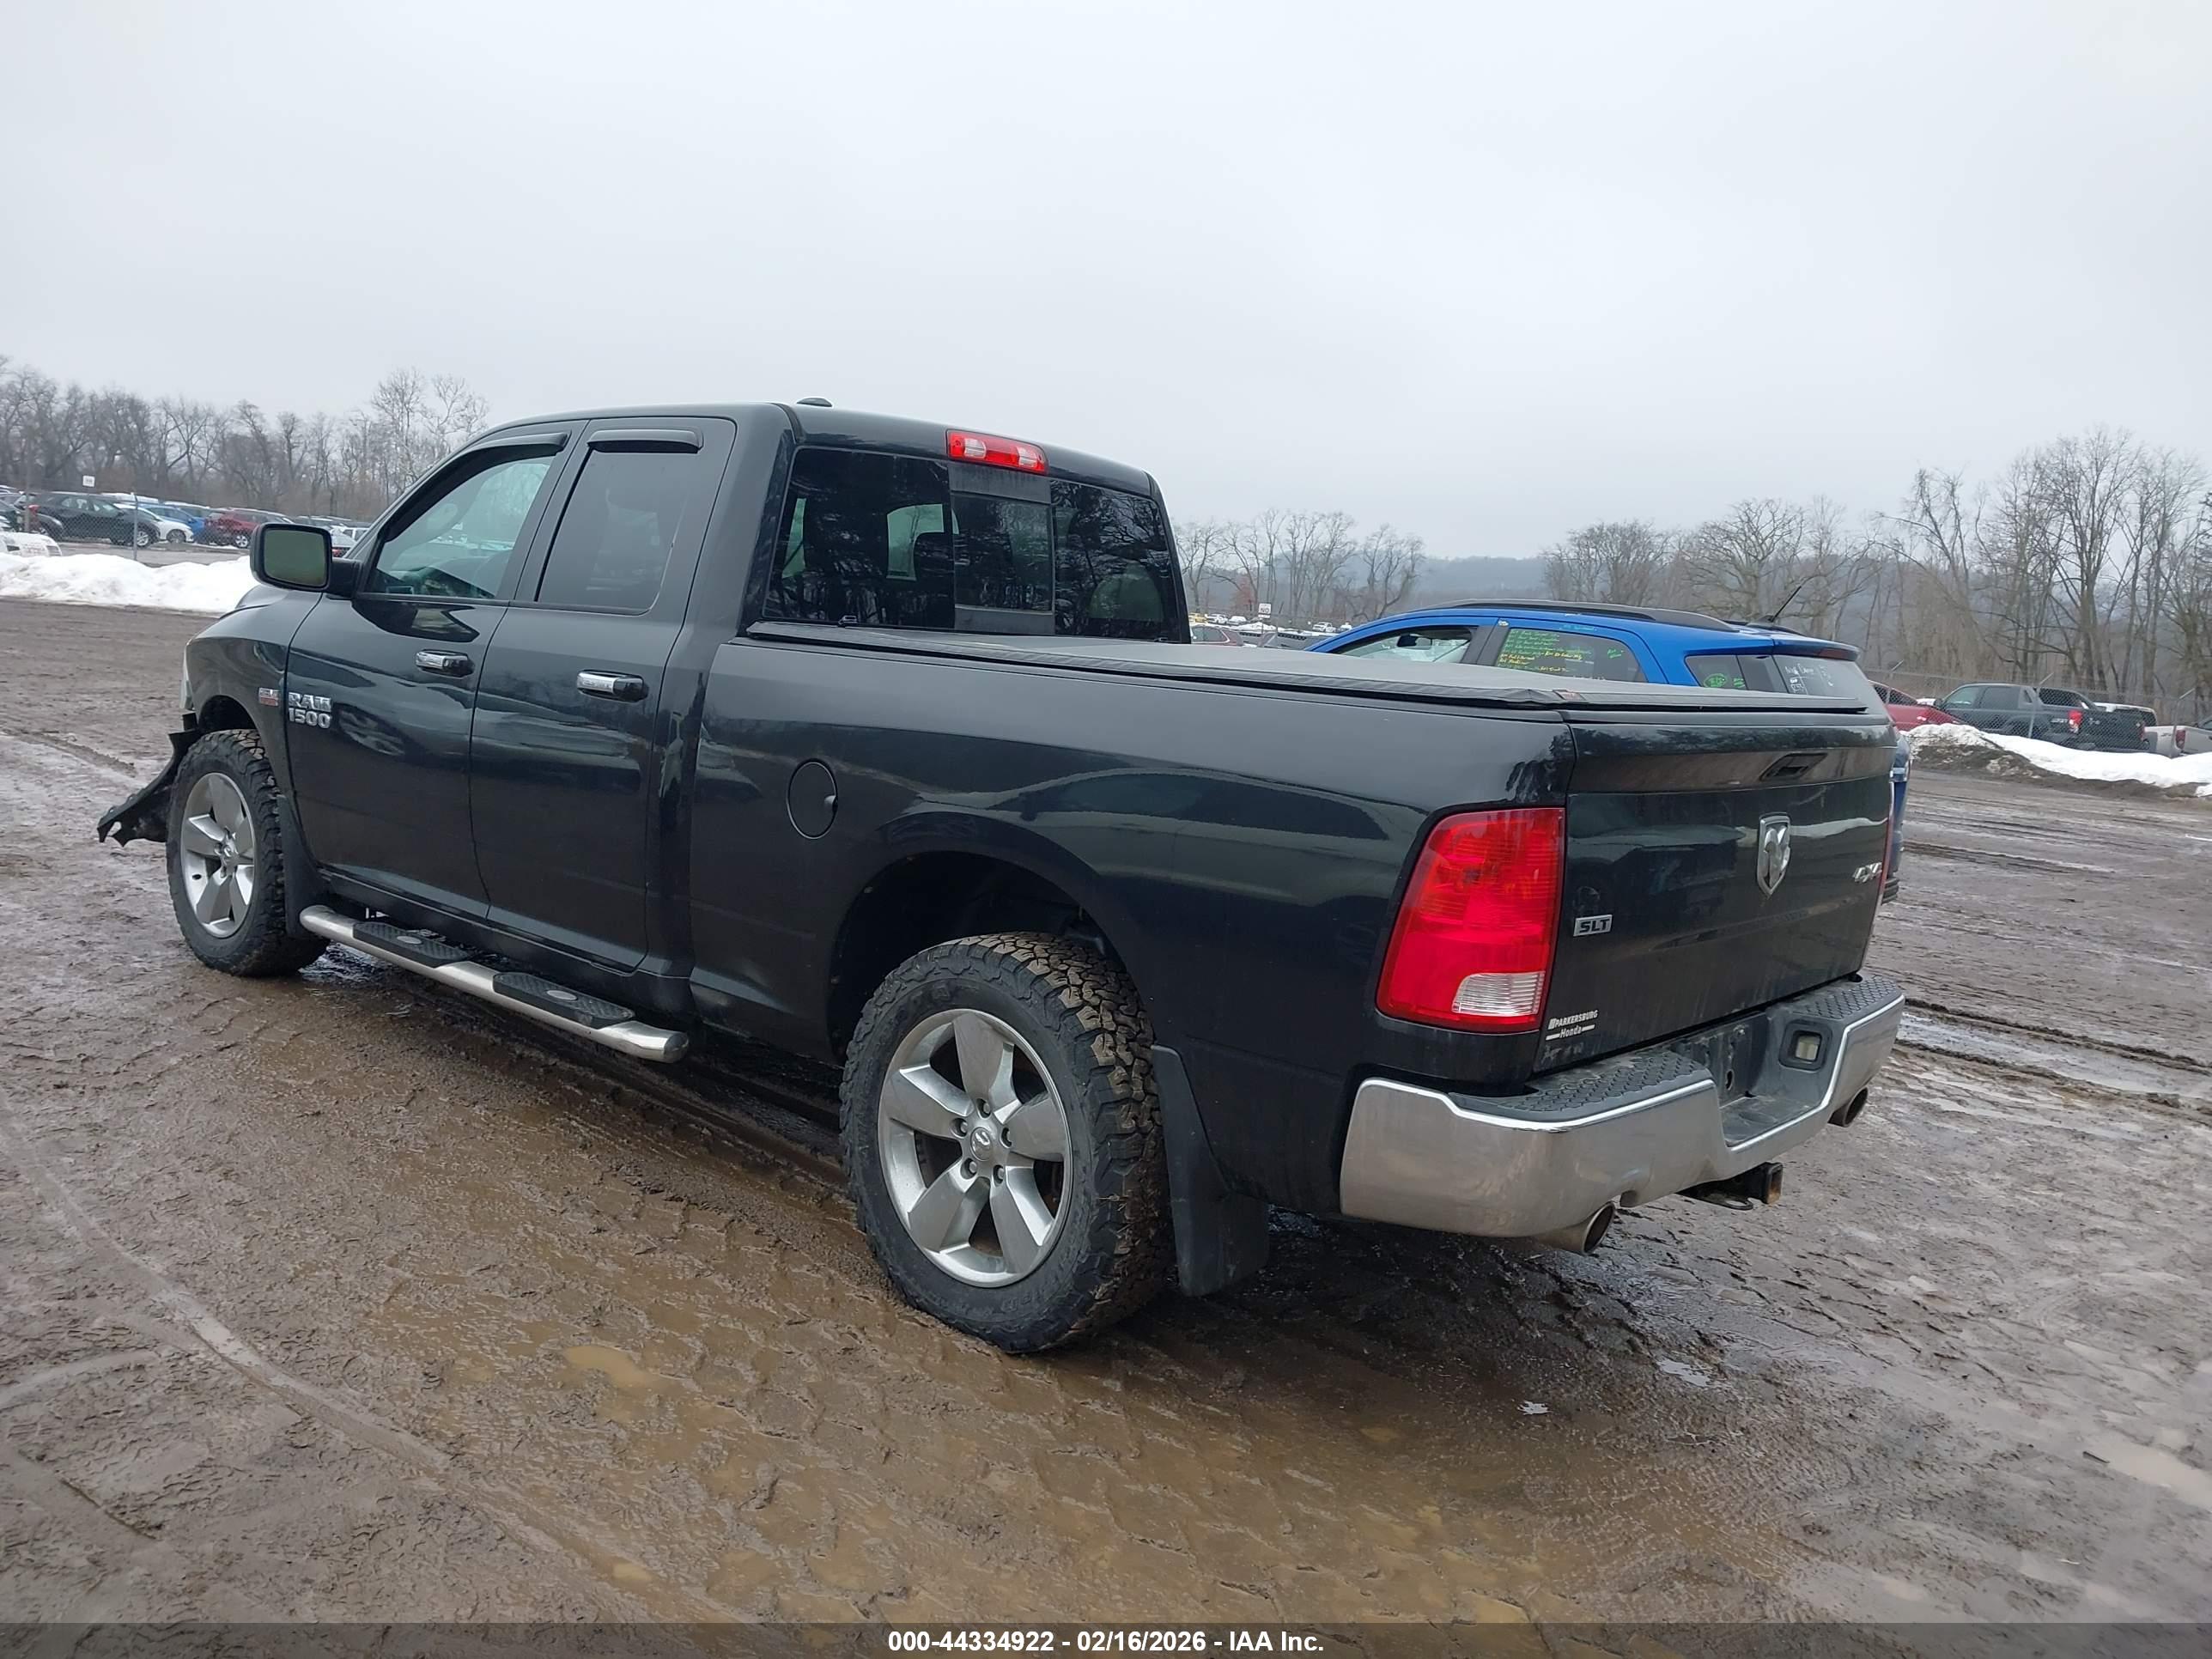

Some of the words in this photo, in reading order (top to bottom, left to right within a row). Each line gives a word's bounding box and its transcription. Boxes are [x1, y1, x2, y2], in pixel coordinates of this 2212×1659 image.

[289, 692, 331, 712] RAM
[289, 708, 331, 729] 1500
[1580, 918, 1610, 933] SLT
[1554, 1010, 1598, 1028] PARKERSBURG
[1559, 1024, 1582, 1039] Honda
